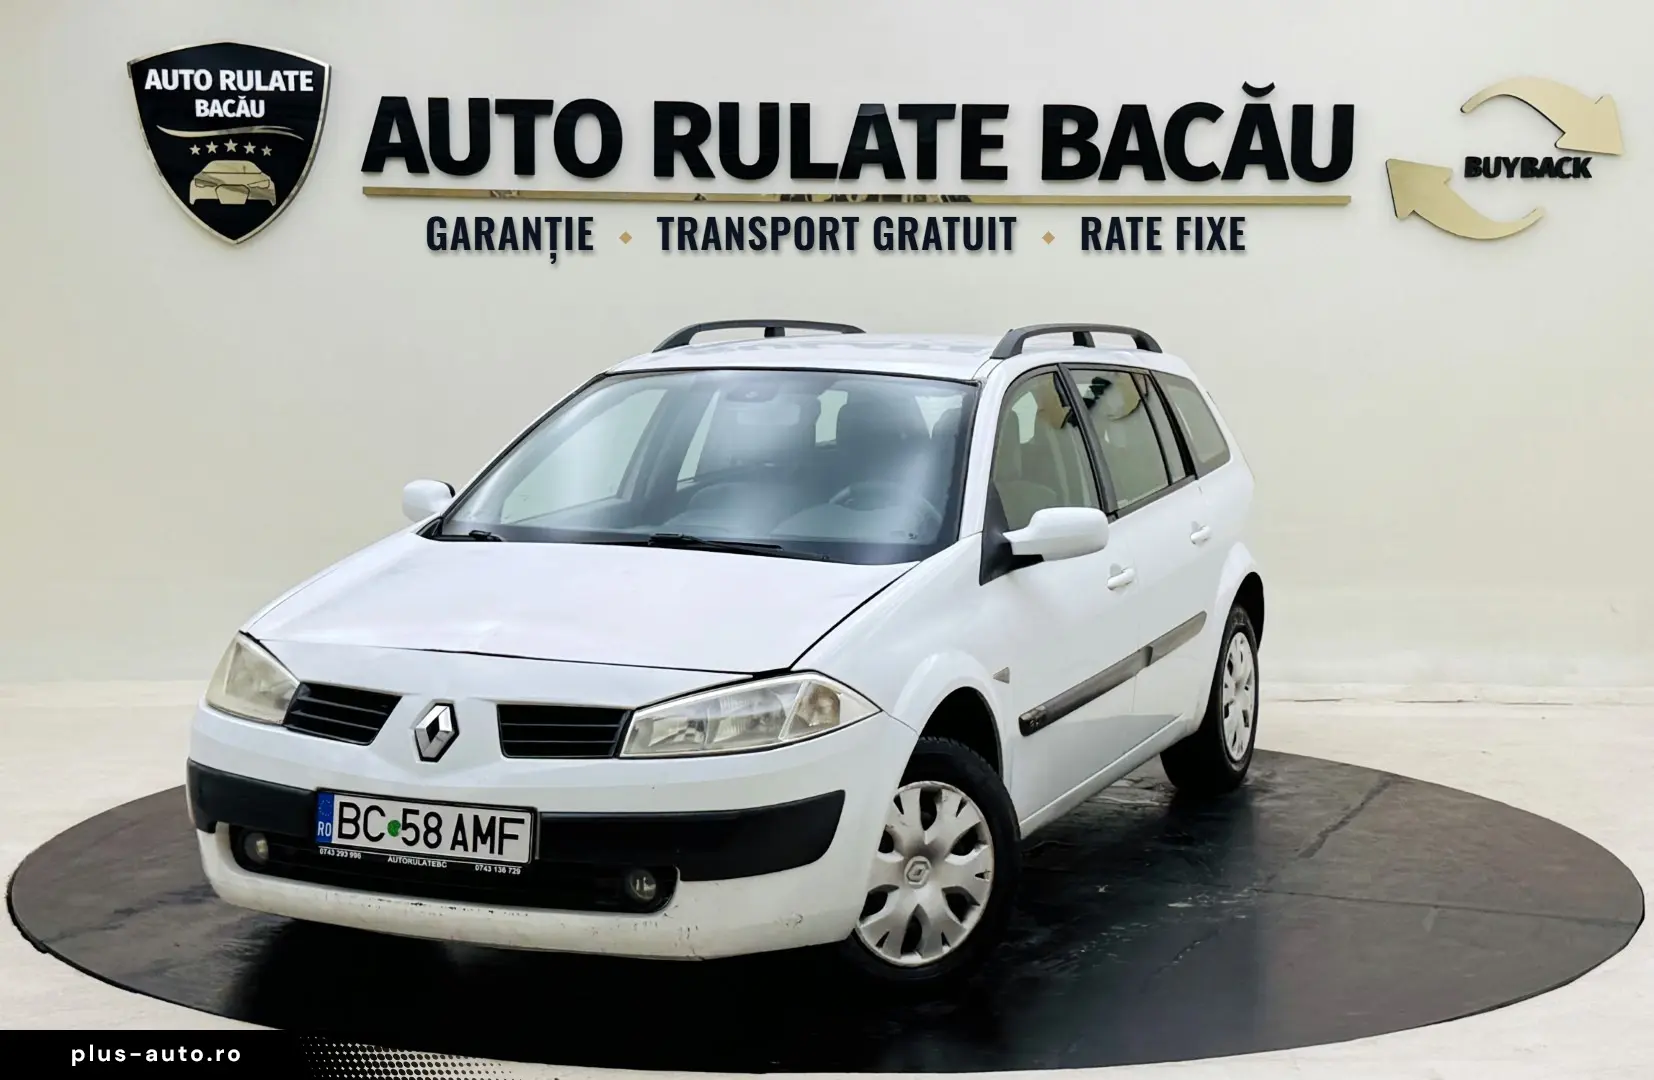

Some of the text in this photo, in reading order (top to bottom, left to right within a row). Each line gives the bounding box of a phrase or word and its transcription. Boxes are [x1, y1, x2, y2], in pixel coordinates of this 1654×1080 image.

[144, 68, 314, 93] AUTO RULATE
[194, 95, 265, 118] BACĂU
[361, 80, 1355, 183] AUTO RULATE BACĂU
[1463, 155, 1593, 179] BUYBACK
[426, 215, 1247, 264] GARANȚIE TRANSPORT GRATUIT RATE FIXE
[317, 801, 525, 855] RO BC 58 AMF
[319, 848, 335, 857] 0743
[387, 856, 448, 868] AUTORULATEBC
[475, 864, 493, 873] 0743
